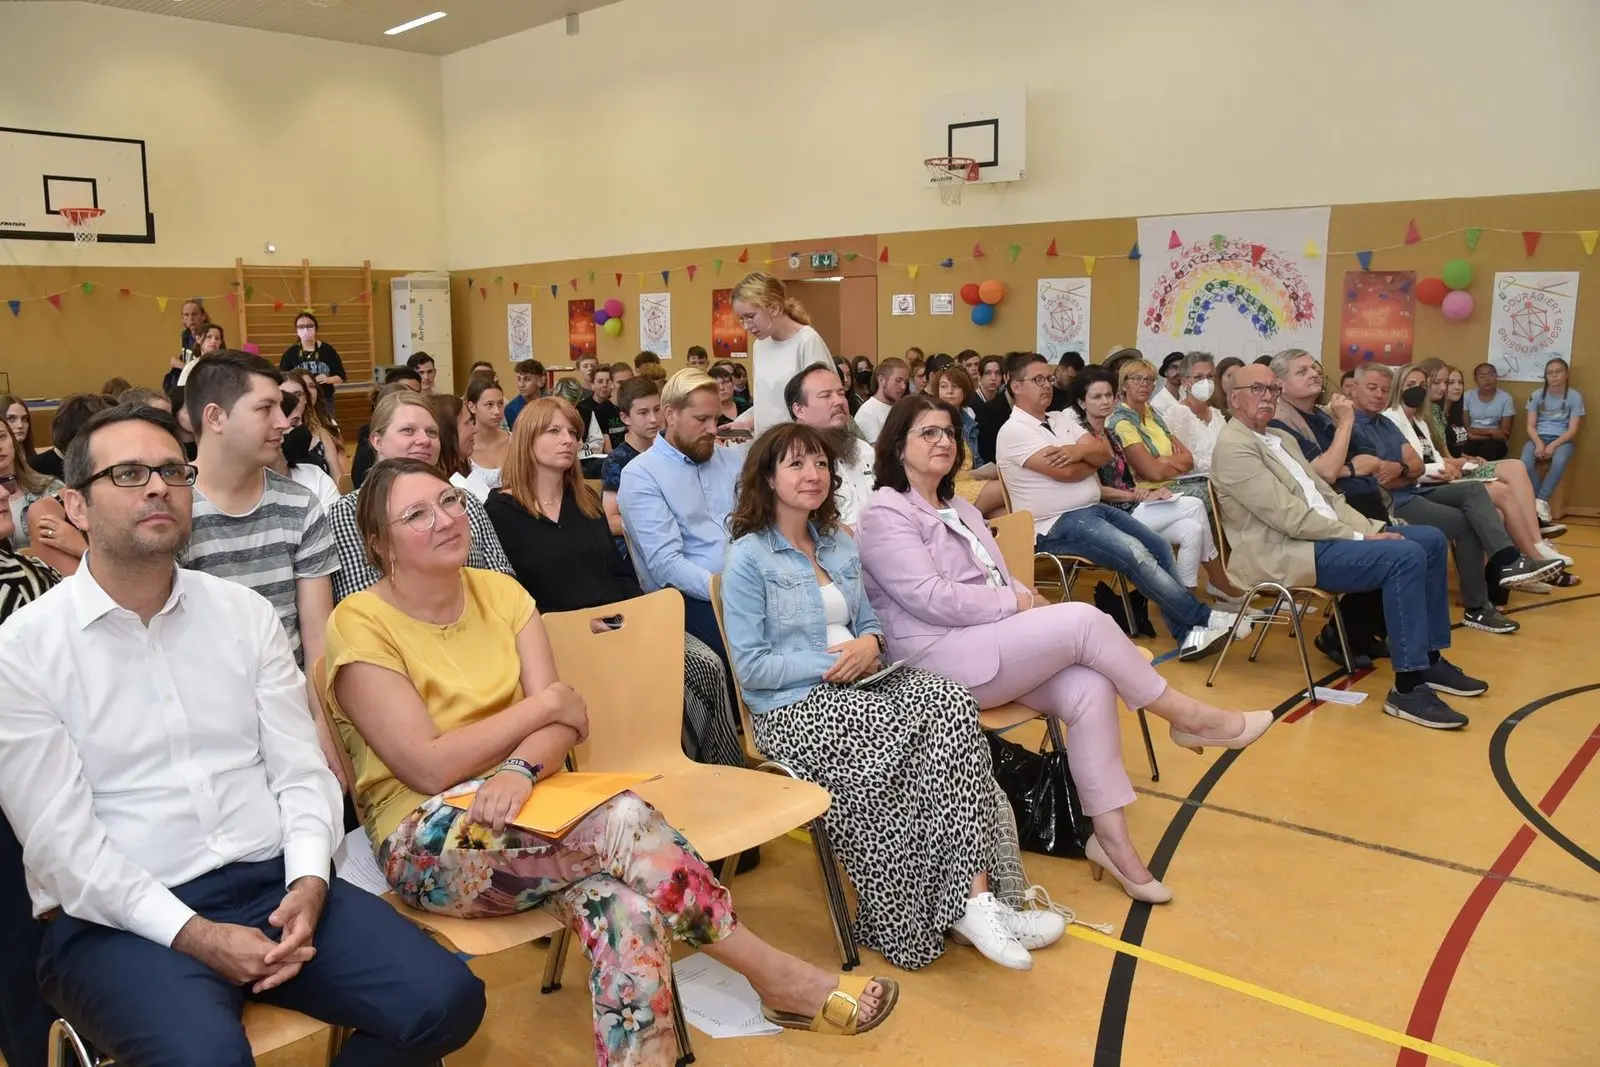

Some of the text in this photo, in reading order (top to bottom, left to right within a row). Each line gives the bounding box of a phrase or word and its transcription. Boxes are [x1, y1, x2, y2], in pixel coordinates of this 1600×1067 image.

[1498, 291, 1563, 354] COURAGIERT GEGEN MOBBING
